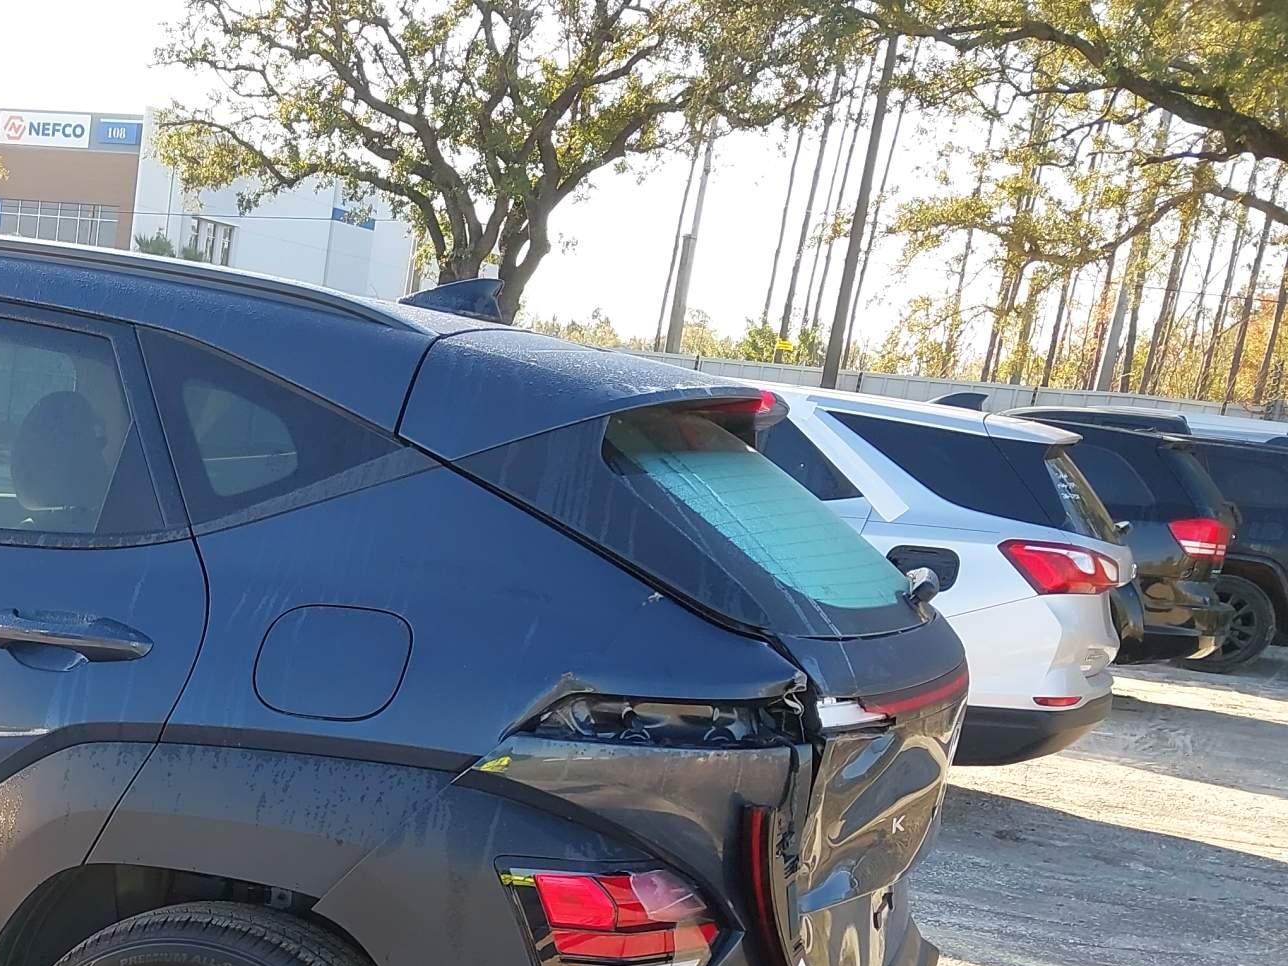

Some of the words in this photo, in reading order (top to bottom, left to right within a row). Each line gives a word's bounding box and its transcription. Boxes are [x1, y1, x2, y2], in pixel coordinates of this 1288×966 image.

[28, 121, 85, 138] NEFCO
[107, 127, 126, 139] 108
[892, 815, 906, 834] K
